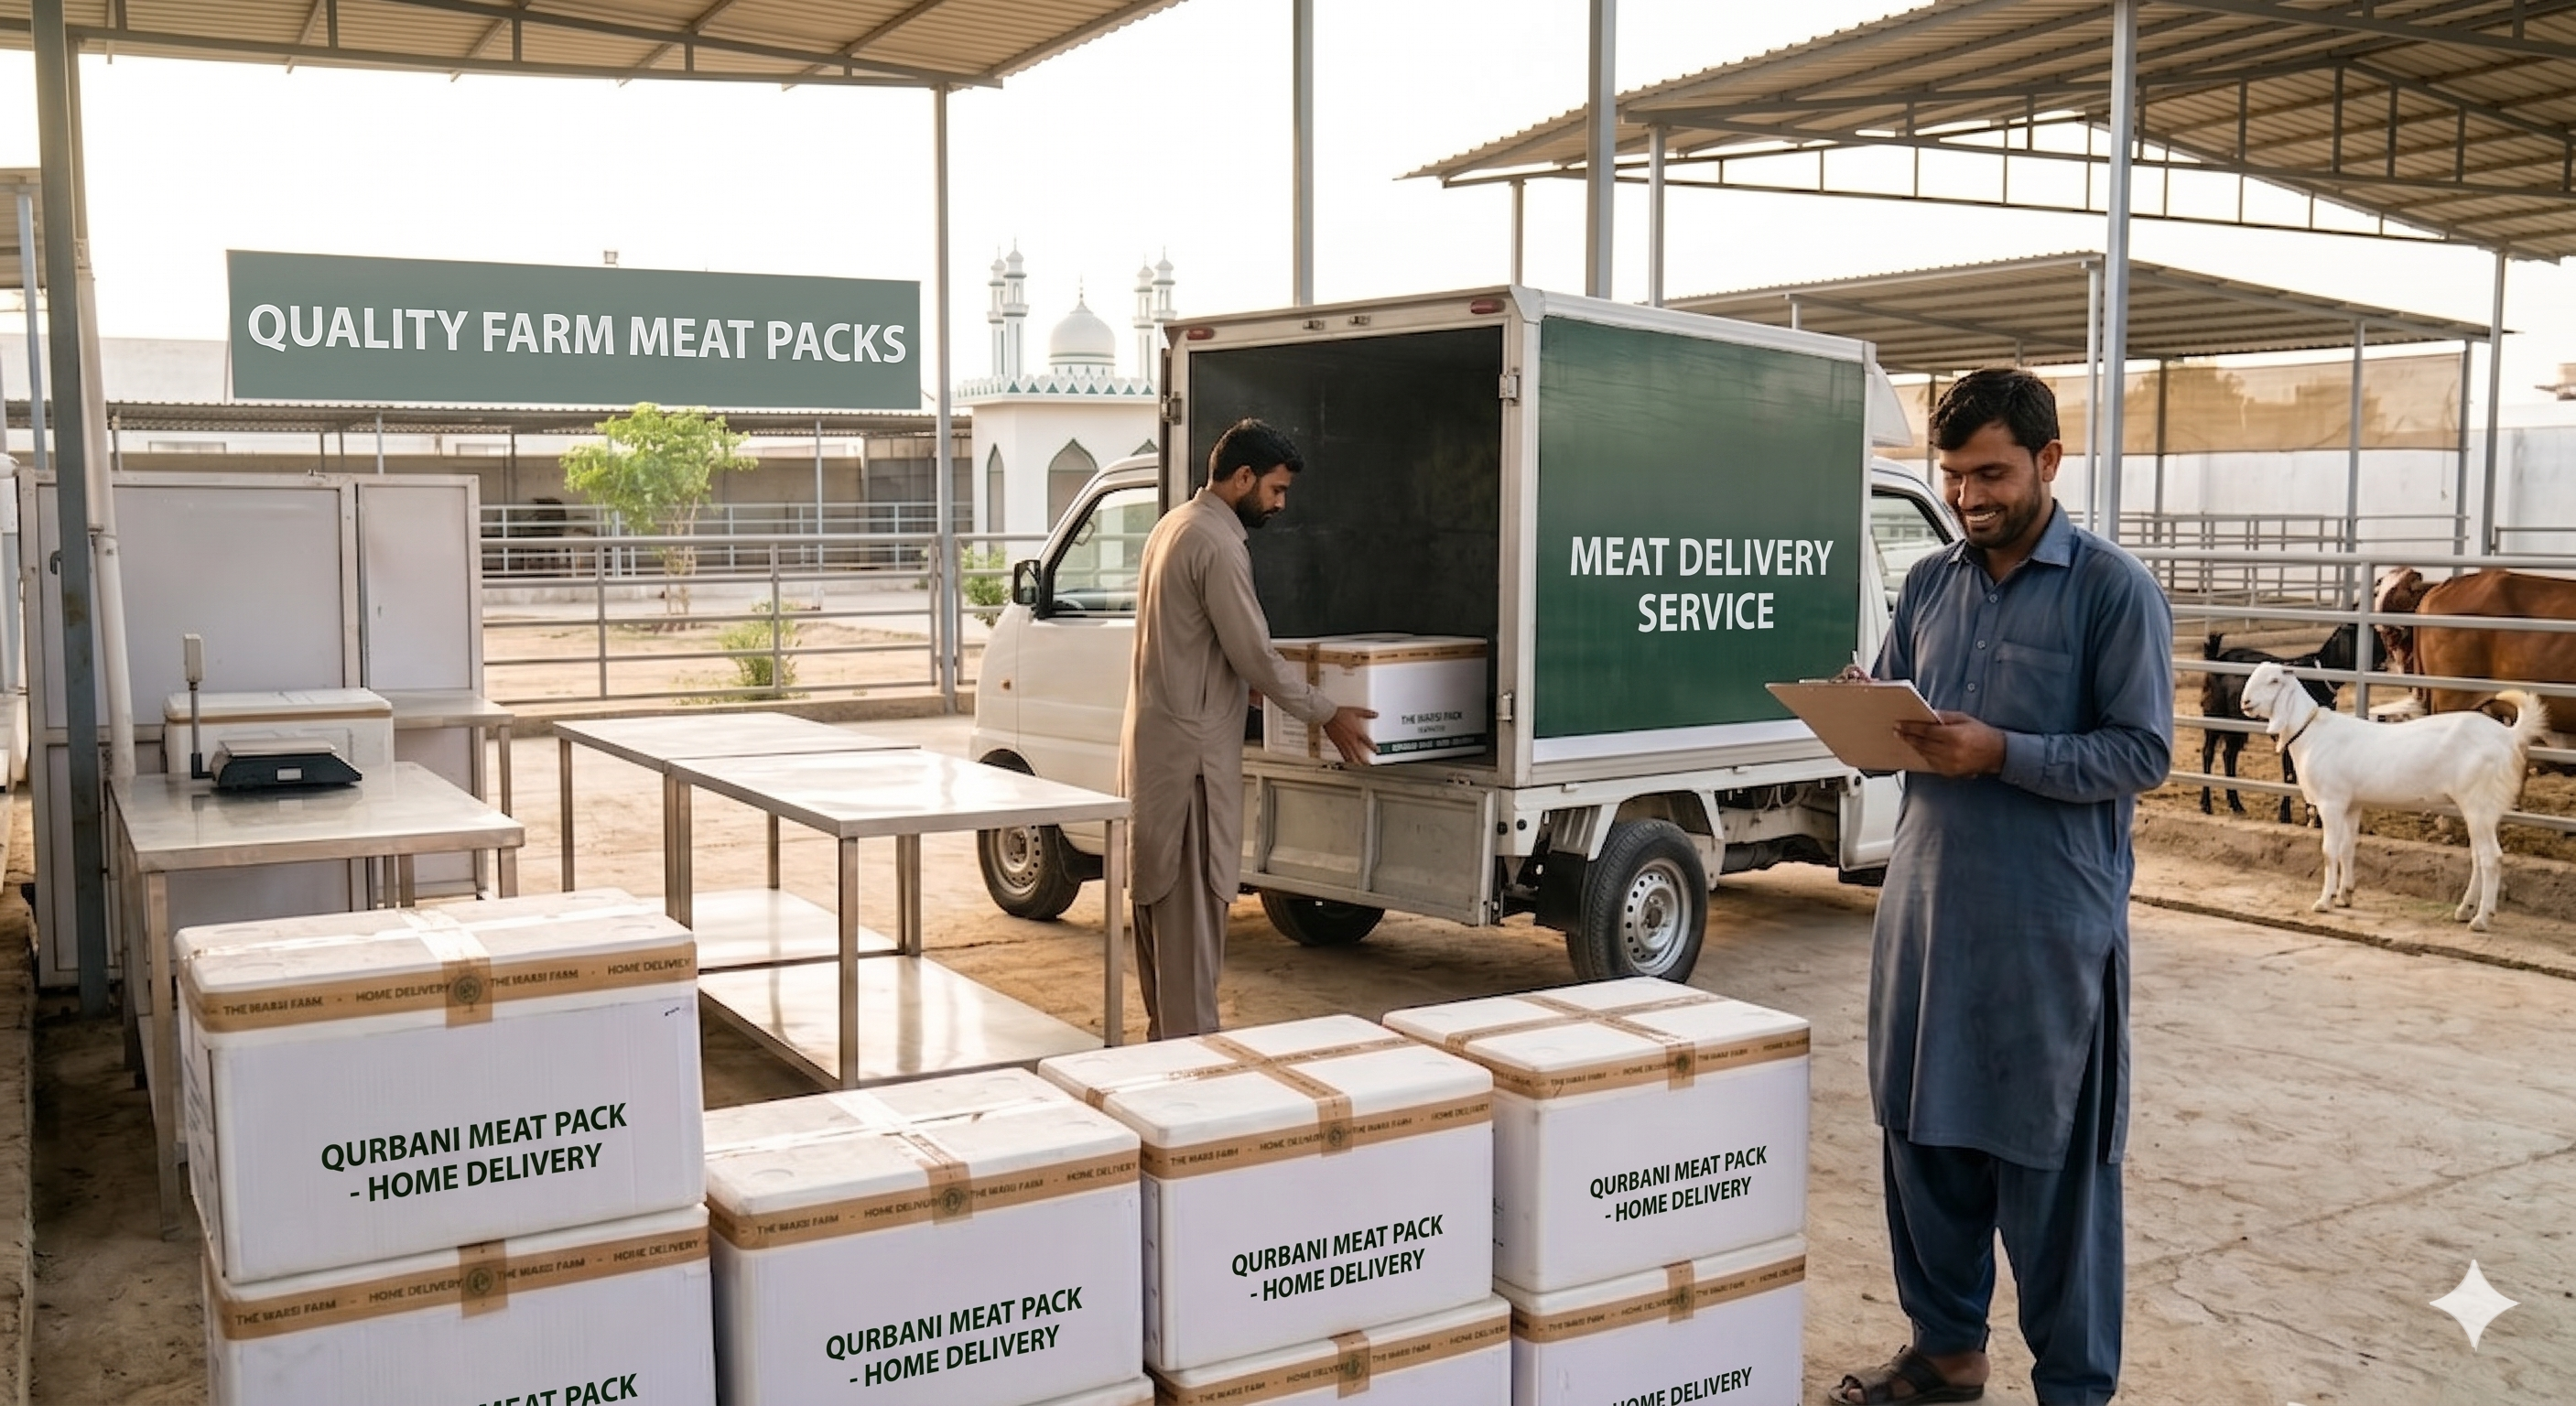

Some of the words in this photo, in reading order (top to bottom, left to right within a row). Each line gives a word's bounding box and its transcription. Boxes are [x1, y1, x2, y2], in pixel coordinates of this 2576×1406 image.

[248, 303, 469, 352] QUALITY
[482, 311, 615, 355] FARM
[629, 316, 754, 359] MEAT
[767, 320, 907, 364] PACKS
[1570, 536, 1670, 577] MEAT
[1680, 537, 1835, 577] DELIVERY
[1638, 592, 1774, 633] SERVICE
[223, 1005, 247, 1016] THE
[356, 989, 393, 1001] HOME
[395, 983, 450, 999] DELIVERY
[491, 976, 510, 988] THE
[608, 962, 640, 975] HOME
[321, 1126, 460, 1173] QURBANI
[469, 1113, 547, 1150] MEAT
[555, 1102, 628, 1137] PACK
[368, 1163, 459, 1202] HOME
[466, 1142, 602, 1187] DELIVERY
[1590, 1164, 1670, 1200] QURBANI
[1674, 1154, 1721, 1182] MEAT
[1725, 1145, 1768, 1172] PACK
[1616, 1193, 1668, 1223] HOME
[1672, 1175, 1752, 1211] DELIVERY
[757, 1223, 776, 1235] THE
[864, 1205, 893, 1217] HOME
[1231, 1238, 1327, 1278] QURBANI
[1333, 1225, 1389, 1258] MEAT
[1393, 1214, 1444, 1245] PACK
[1263, 1269, 1325, 1302] HOME
[1330, 1248, 1425, 1288] DELIVERY
[235, 1314, 259, 1326] THE
[368, 1288, 404, 1303] HOME
[826, 1314, 942, 1361] QURBANI
[949, 1299, 1016, 1336] MEAT
[1022, 1286, 1083, 1321] PACK
[865, 1349, 939, 1388] HOME
[947, 1324, 1060, 1370] DELIVERY
[565, 1372, 638, 1406] PACK
[1671, 1366, 1753, 1406] DELIVERY
